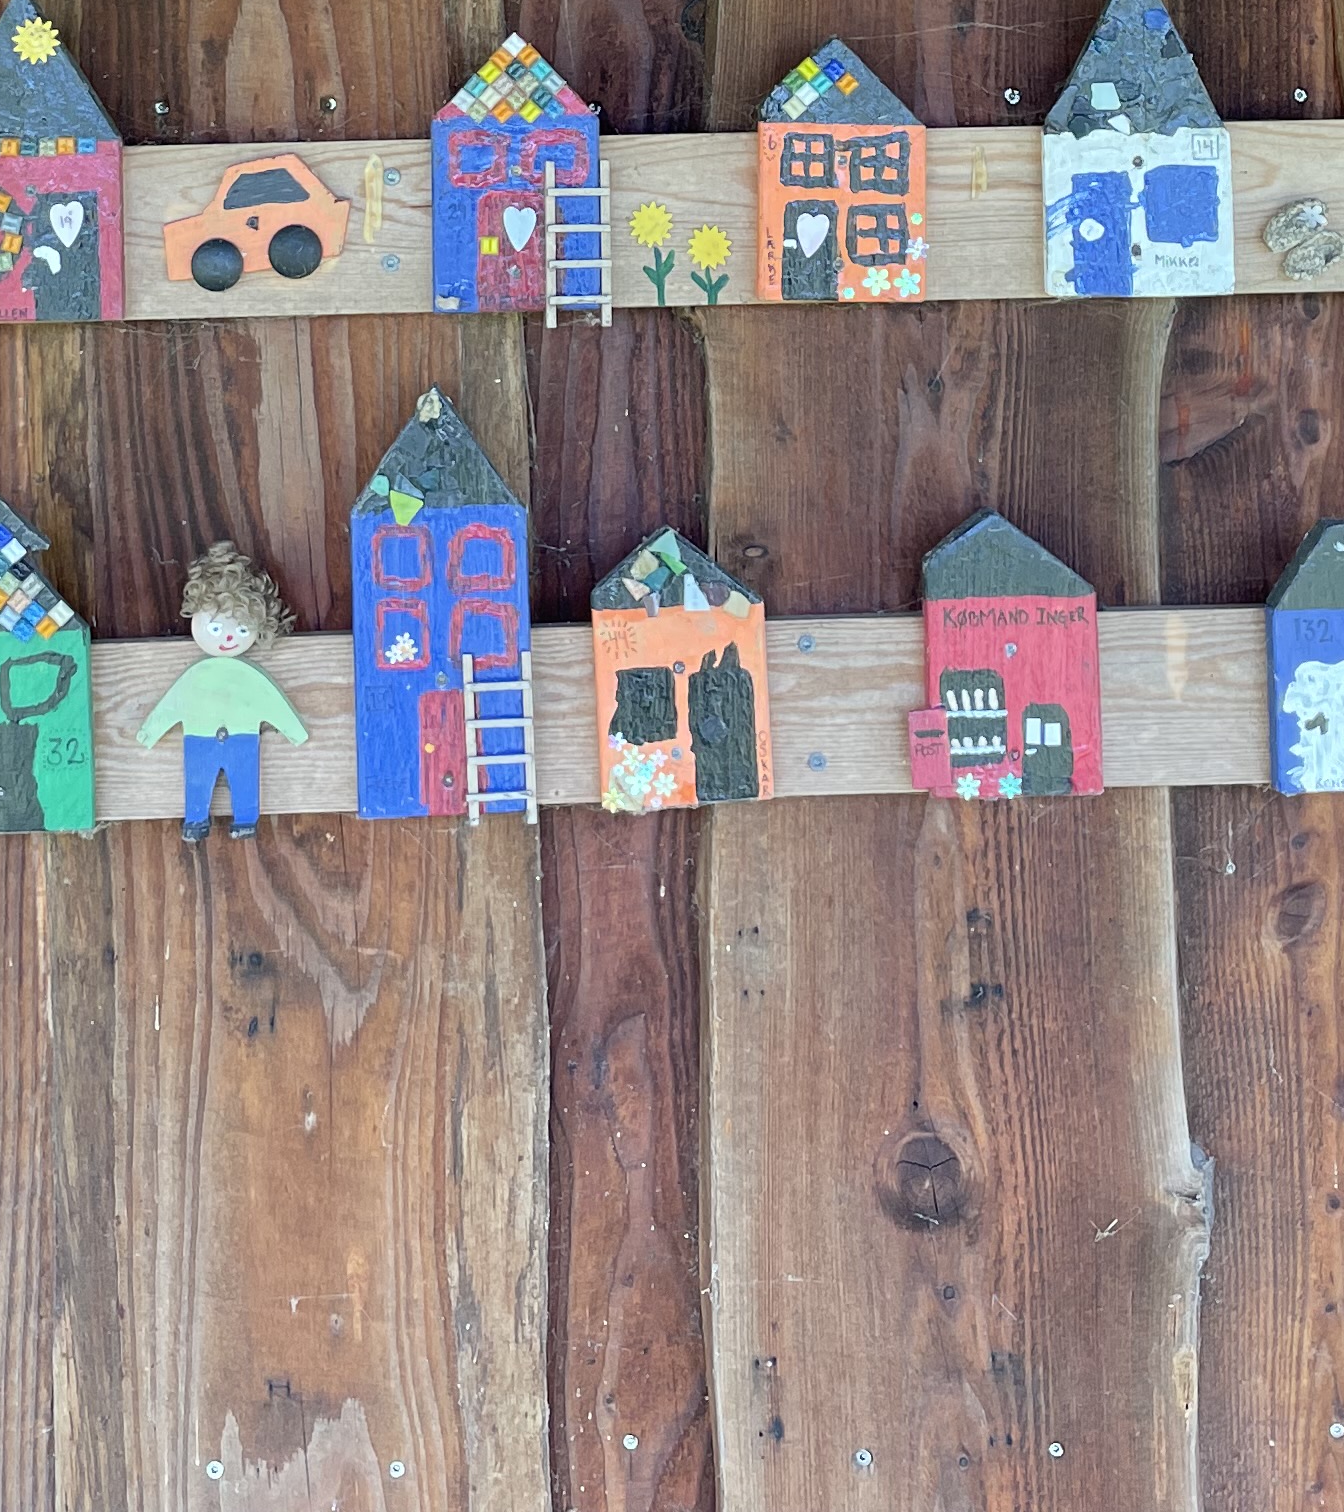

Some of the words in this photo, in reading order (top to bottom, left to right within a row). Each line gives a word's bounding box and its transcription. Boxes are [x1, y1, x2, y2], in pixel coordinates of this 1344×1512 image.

[768, 135, 776, 150] 6
[1197, 139, 1213, 157] 14
[943, 606, 1029, 631] KØBMAND
[1036, 606, 1089, 630] INGER
[608, 630, 629, 650] 44
[1293, 617, 1333, 643] 132
[47, 737, 85, 765] 32
[915, 743, 944, 757] POST
[758, 731, 771, 796] OSKAR
